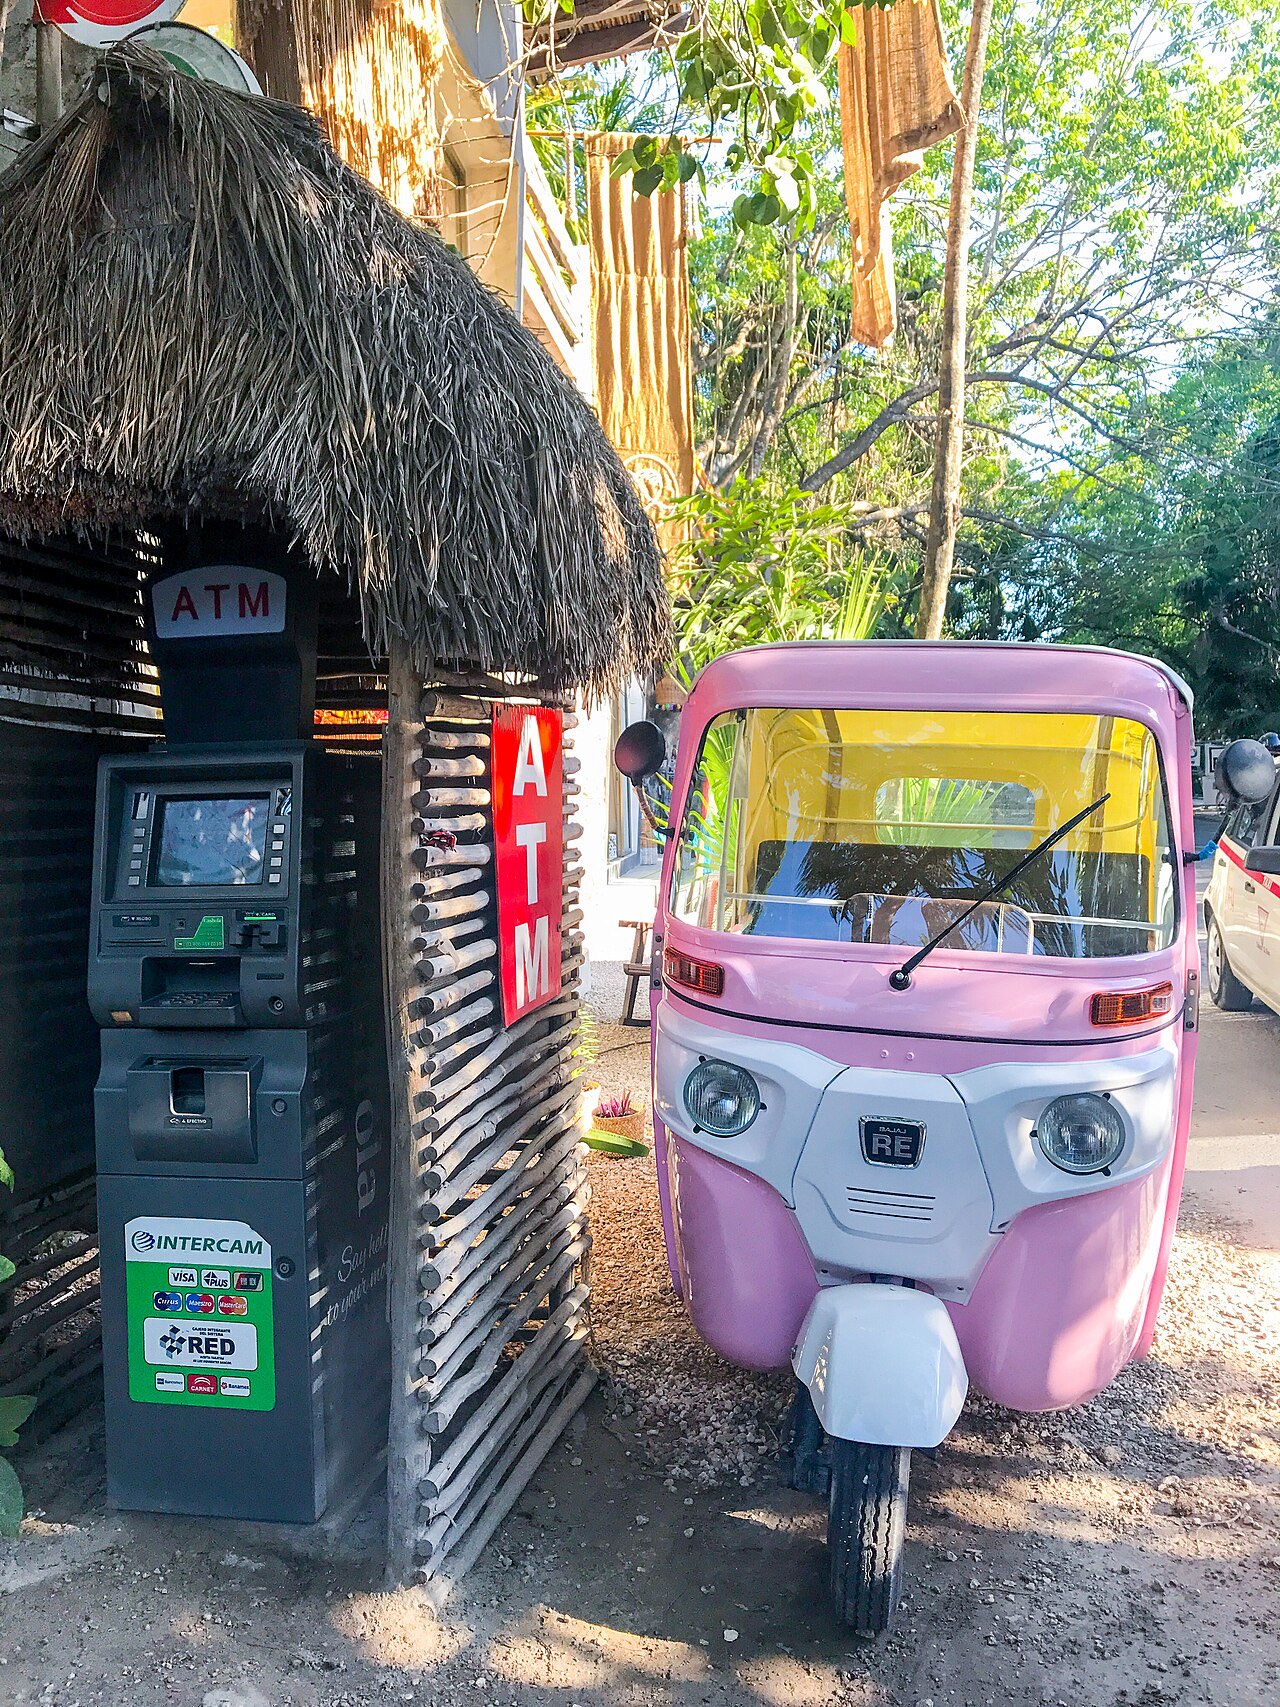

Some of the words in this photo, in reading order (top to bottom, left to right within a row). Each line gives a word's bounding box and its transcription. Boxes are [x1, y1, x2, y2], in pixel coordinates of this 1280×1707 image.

[171, 582, 269, 621] ATM
[512, 714, 549, 1010] ATM
[879, 1126, 907, 1134] BAJAJ
[872, 1133, 913, 1158] RE
[156, 1235, 263, 1255] INTERCAM
[338, 1245, 367, 1282] Say
[368, 1222, 388, 1259] hell
[172, 1272, 195, 1283] VISA
[209, 1279, 229, 1287] PLUS
[157, 1297, 179, 1305] Cirrus
[188, 1299, 212, 1307] Maestro
[219, 1301, 247, 1309] MasterCard
[188, 1336, 236, 1355] RED
